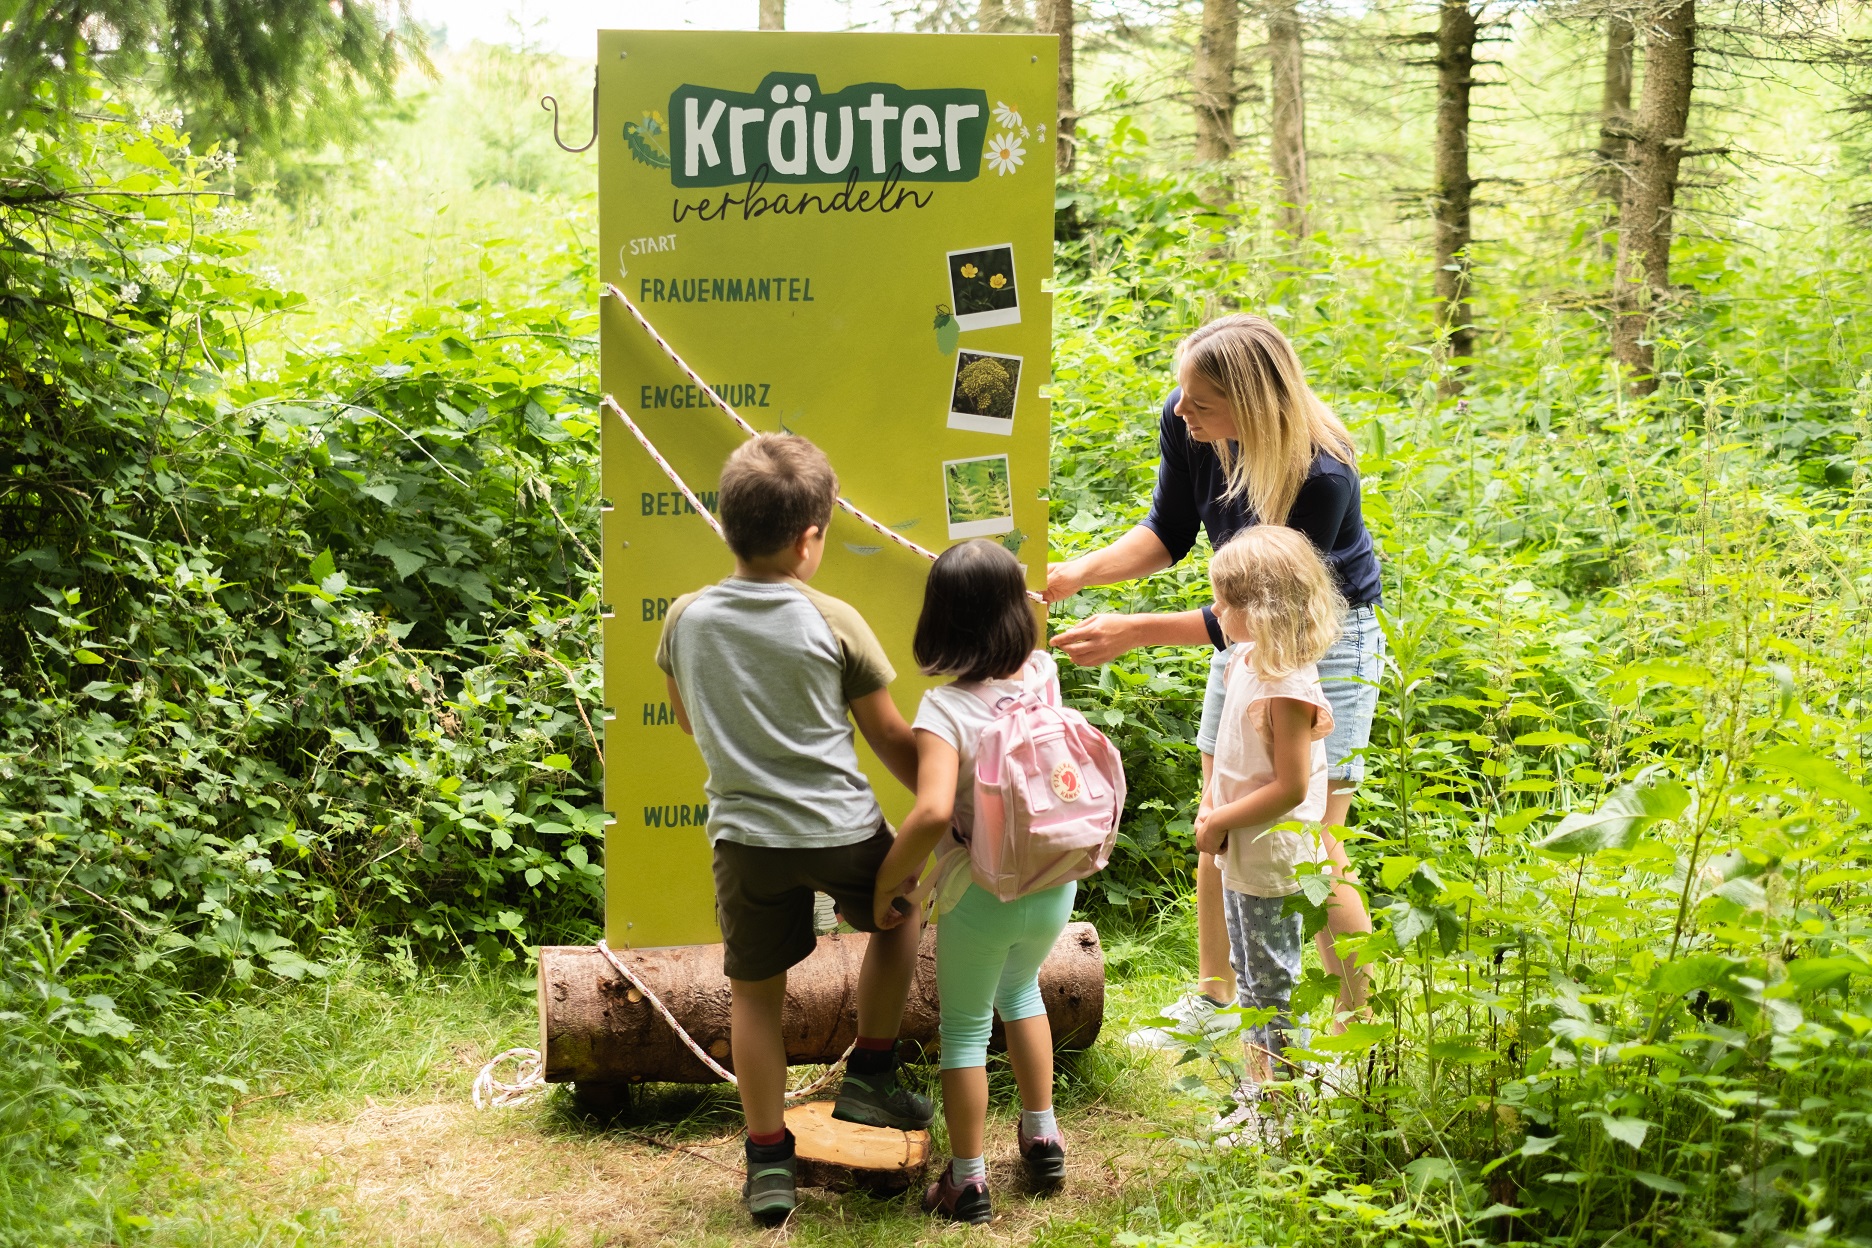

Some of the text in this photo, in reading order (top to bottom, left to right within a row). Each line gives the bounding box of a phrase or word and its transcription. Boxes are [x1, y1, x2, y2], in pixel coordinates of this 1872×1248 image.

[673, 162, 934, 224] verbandeln
[630, 234, 677, 256] START
[640, 278, 815, 303] FRAUENMANTEL
[641, 383, 771, 409] ENGELWURZ
[642, 597, 678, 622] BR
